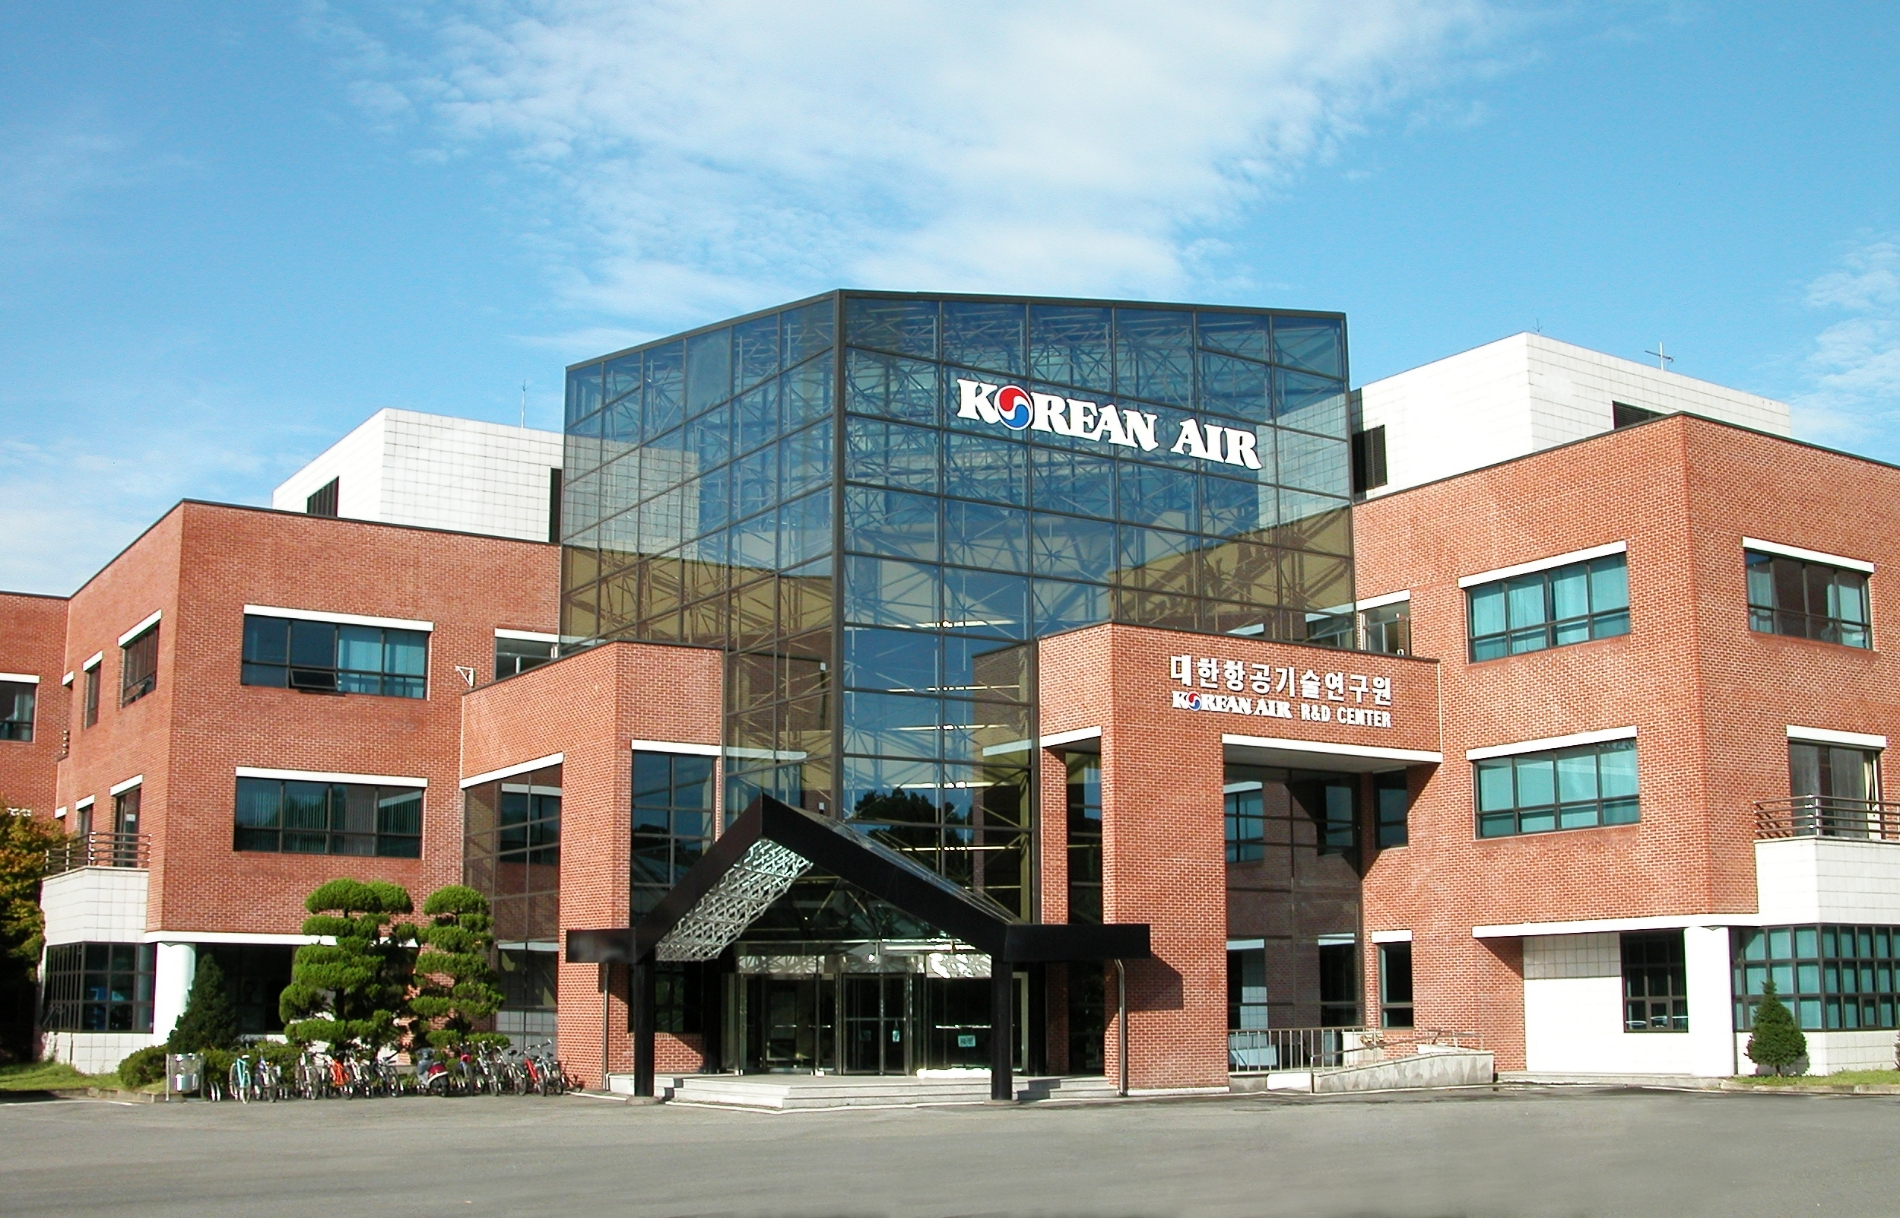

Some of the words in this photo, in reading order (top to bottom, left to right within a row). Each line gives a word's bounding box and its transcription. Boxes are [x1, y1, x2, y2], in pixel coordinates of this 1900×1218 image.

[956, 378, 1159, 452] KOREAN
[1170, 418, 1263, 470] AIR
[1170, 654, 1392, 706] 대한항공기술연구원
[1171, 690, 1252, 715] KOREAN
[1254, 698, 1293, 719] AIR
[1301, 703, 1331, 722] R&D
[1337, 706, 1392, 728] CENTER
